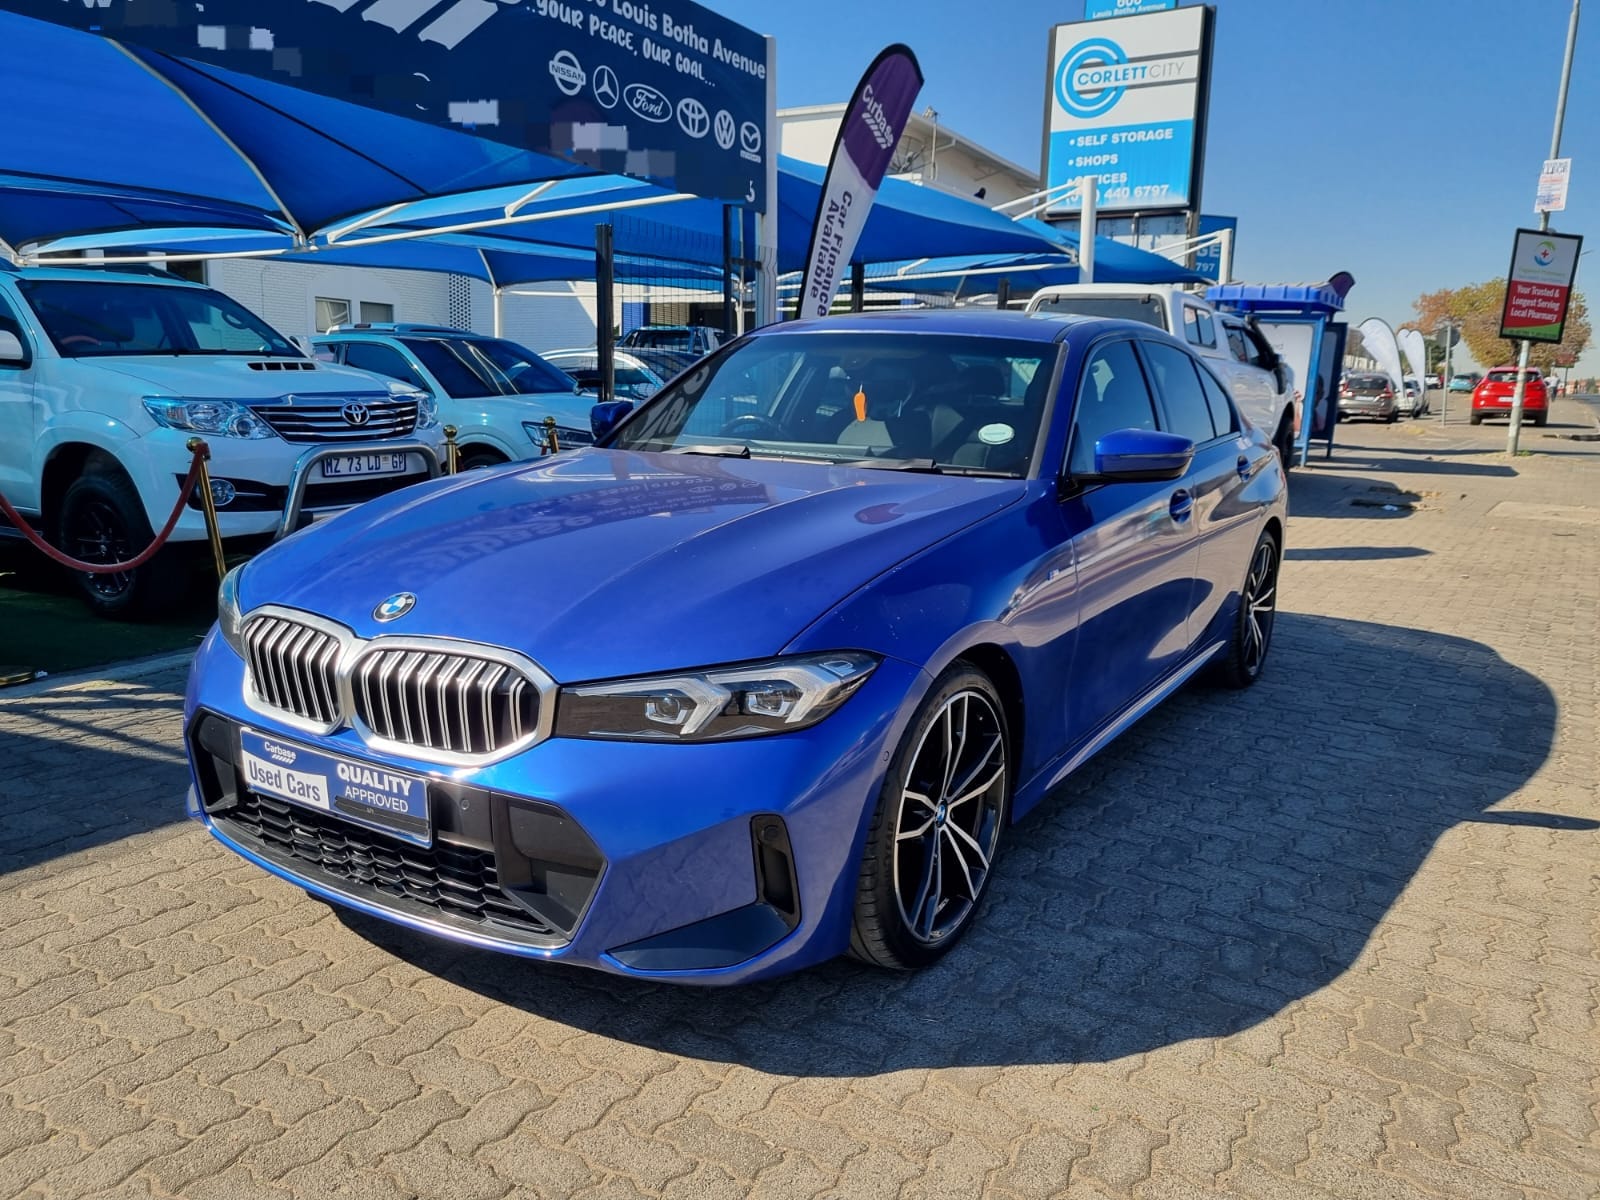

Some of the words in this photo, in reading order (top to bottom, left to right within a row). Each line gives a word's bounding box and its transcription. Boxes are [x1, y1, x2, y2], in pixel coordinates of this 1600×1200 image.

[613, 0, 658, 31] Louis
[663, 13, 709, 55] Botha
[713, 38, 766, 79] Avenue
[551, 63, 584, 81] NISSAN
[633, 88, 664, 117] Ford
[1076, 134, 1108, 147] SELF
[1111, 128, 1173, 144] STORAGE
[1075, 154, 1119, 167] SHOPS
[1104, 185, 1130, 200] 440
[1133, 184, 1170, 198] 6797
[838, 190, 853, 229] Car
[810, 199, 840, 298] Available
[816, 232, 843, 317] Finance
[1517, 284, 1532, 294] Your
[1531, 286, 1553, 298] Trusted
[1512, 296, 1537, 308] Longest
[1510, 307, 1528, 319] Local
[1528, 309, 1558, 323] Pharmacy
[347, 456, 362, 473] 73
[367, 455, 381, 471] LD
[391, 453, 404, 470] GP
[264, 741, 296, 759] Carbase
[249, 759, 282, 789] Used
[287, 772, 321, 802] Cars
[336, 762, 412, 796] QUALITY
[345, 784, 409, 812] APPROVED
